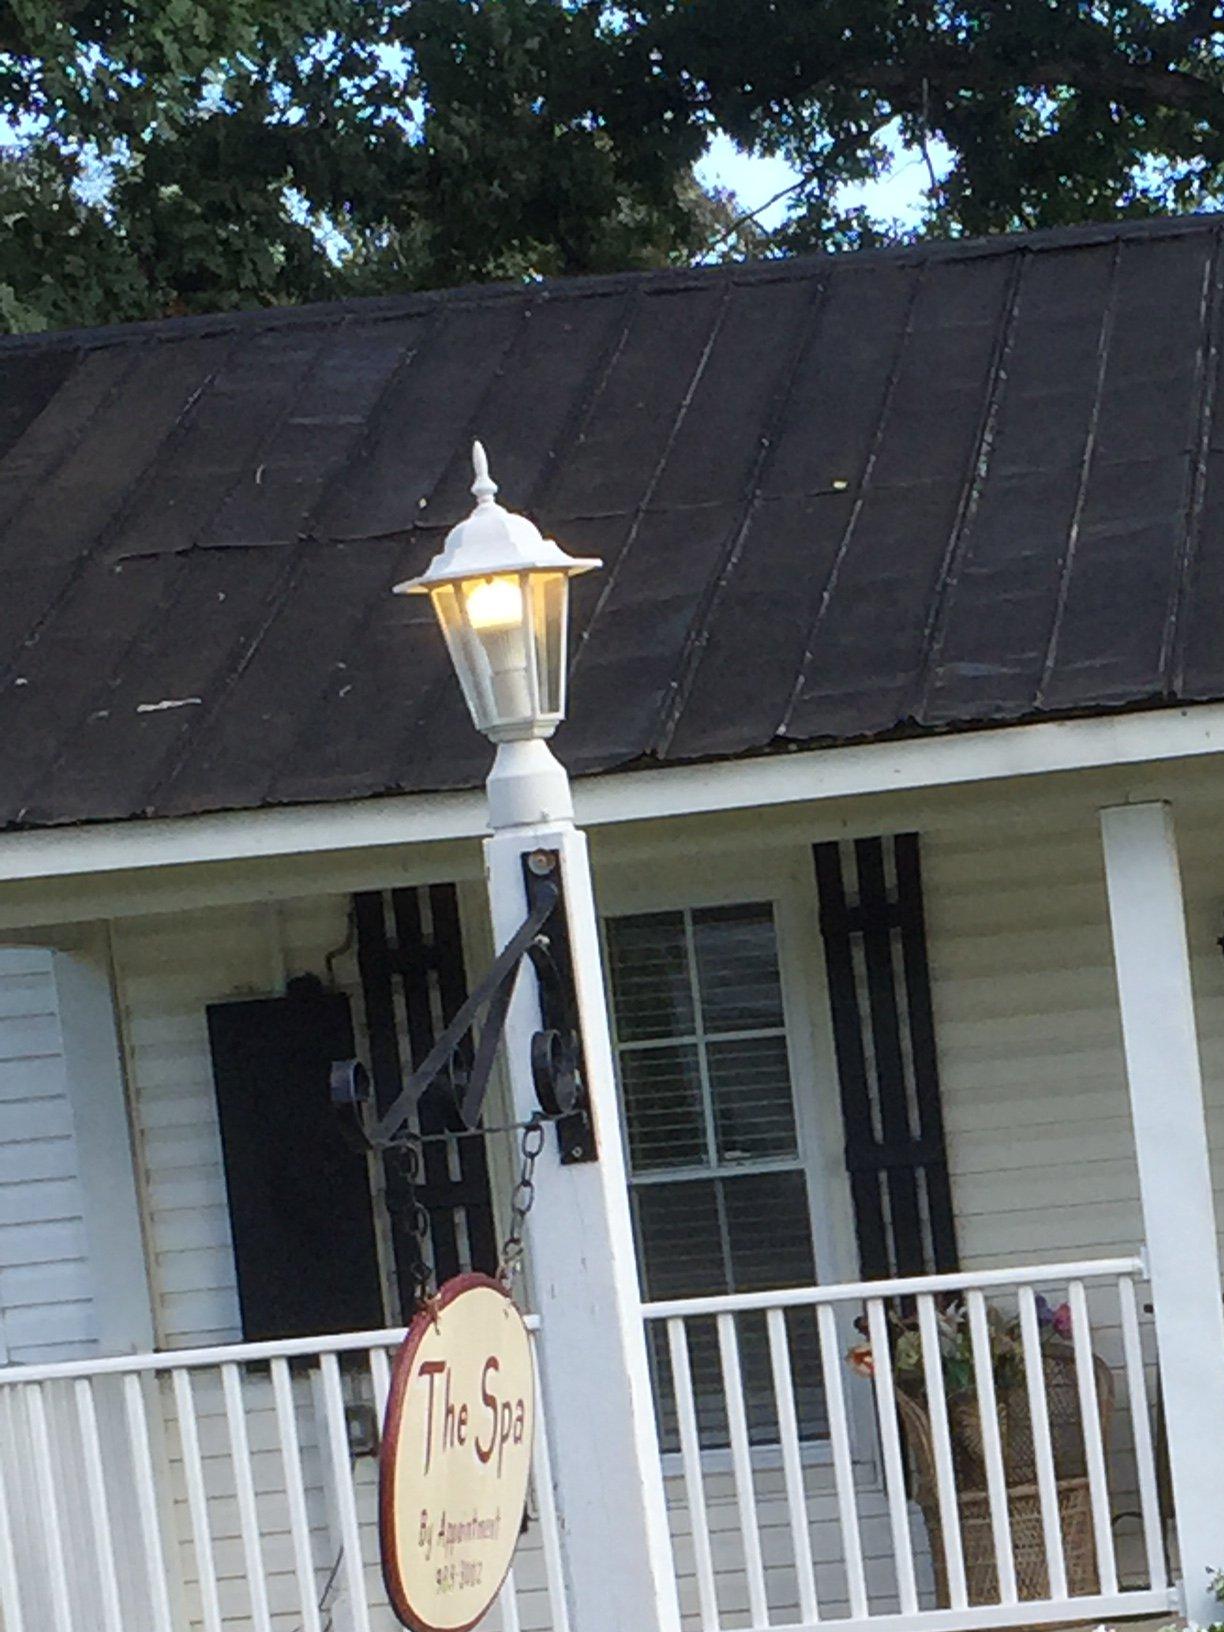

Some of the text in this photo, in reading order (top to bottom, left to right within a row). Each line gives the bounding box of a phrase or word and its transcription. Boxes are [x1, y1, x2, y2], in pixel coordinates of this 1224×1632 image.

[418, 1354, 526, 1480] The Spa
[418, 1506, 501, 1561] By Appointment
